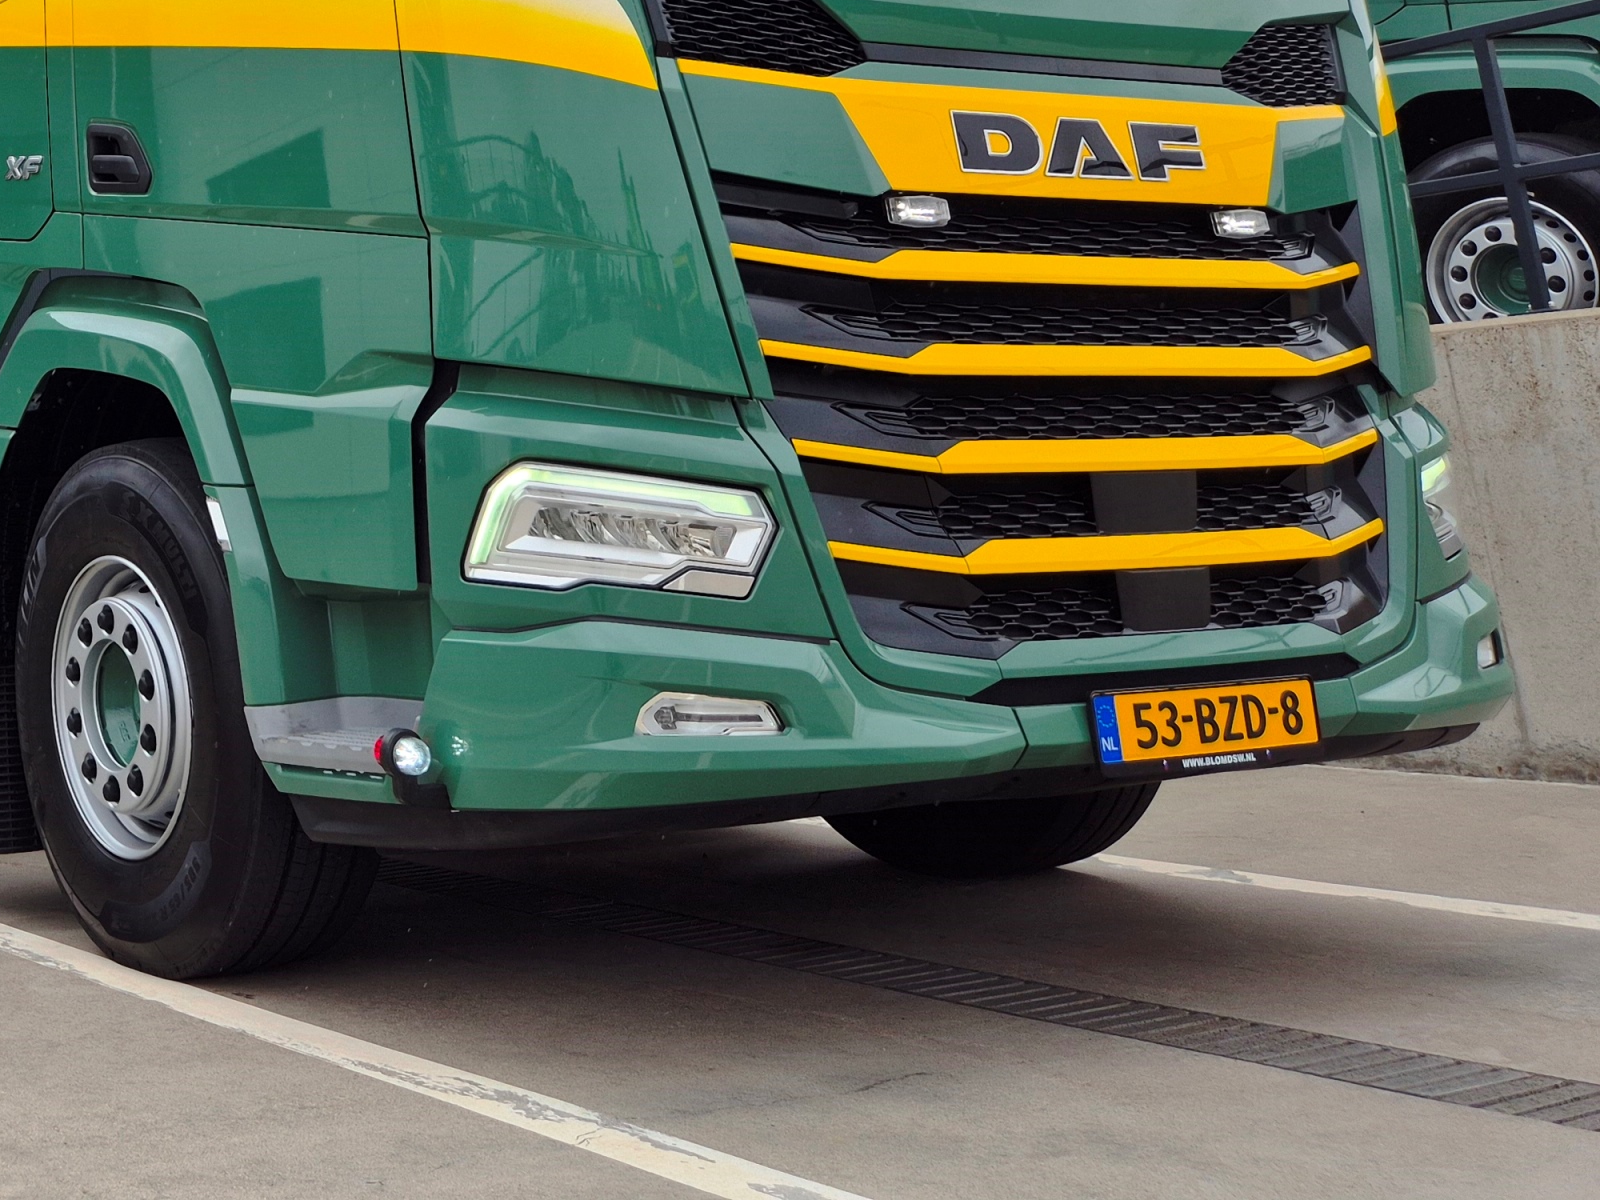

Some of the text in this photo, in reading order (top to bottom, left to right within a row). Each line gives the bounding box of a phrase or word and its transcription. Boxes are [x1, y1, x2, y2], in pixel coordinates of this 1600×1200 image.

[949, 109, 1206, 181] DAF
[5, 154, 43, 180] XF
[1132, 689, 1304, 750] 53-BZD-8
[1101, 736, 1118, 752] NL
[1181, 752, 1257, 768] WWW.BLOMDSW.NL
